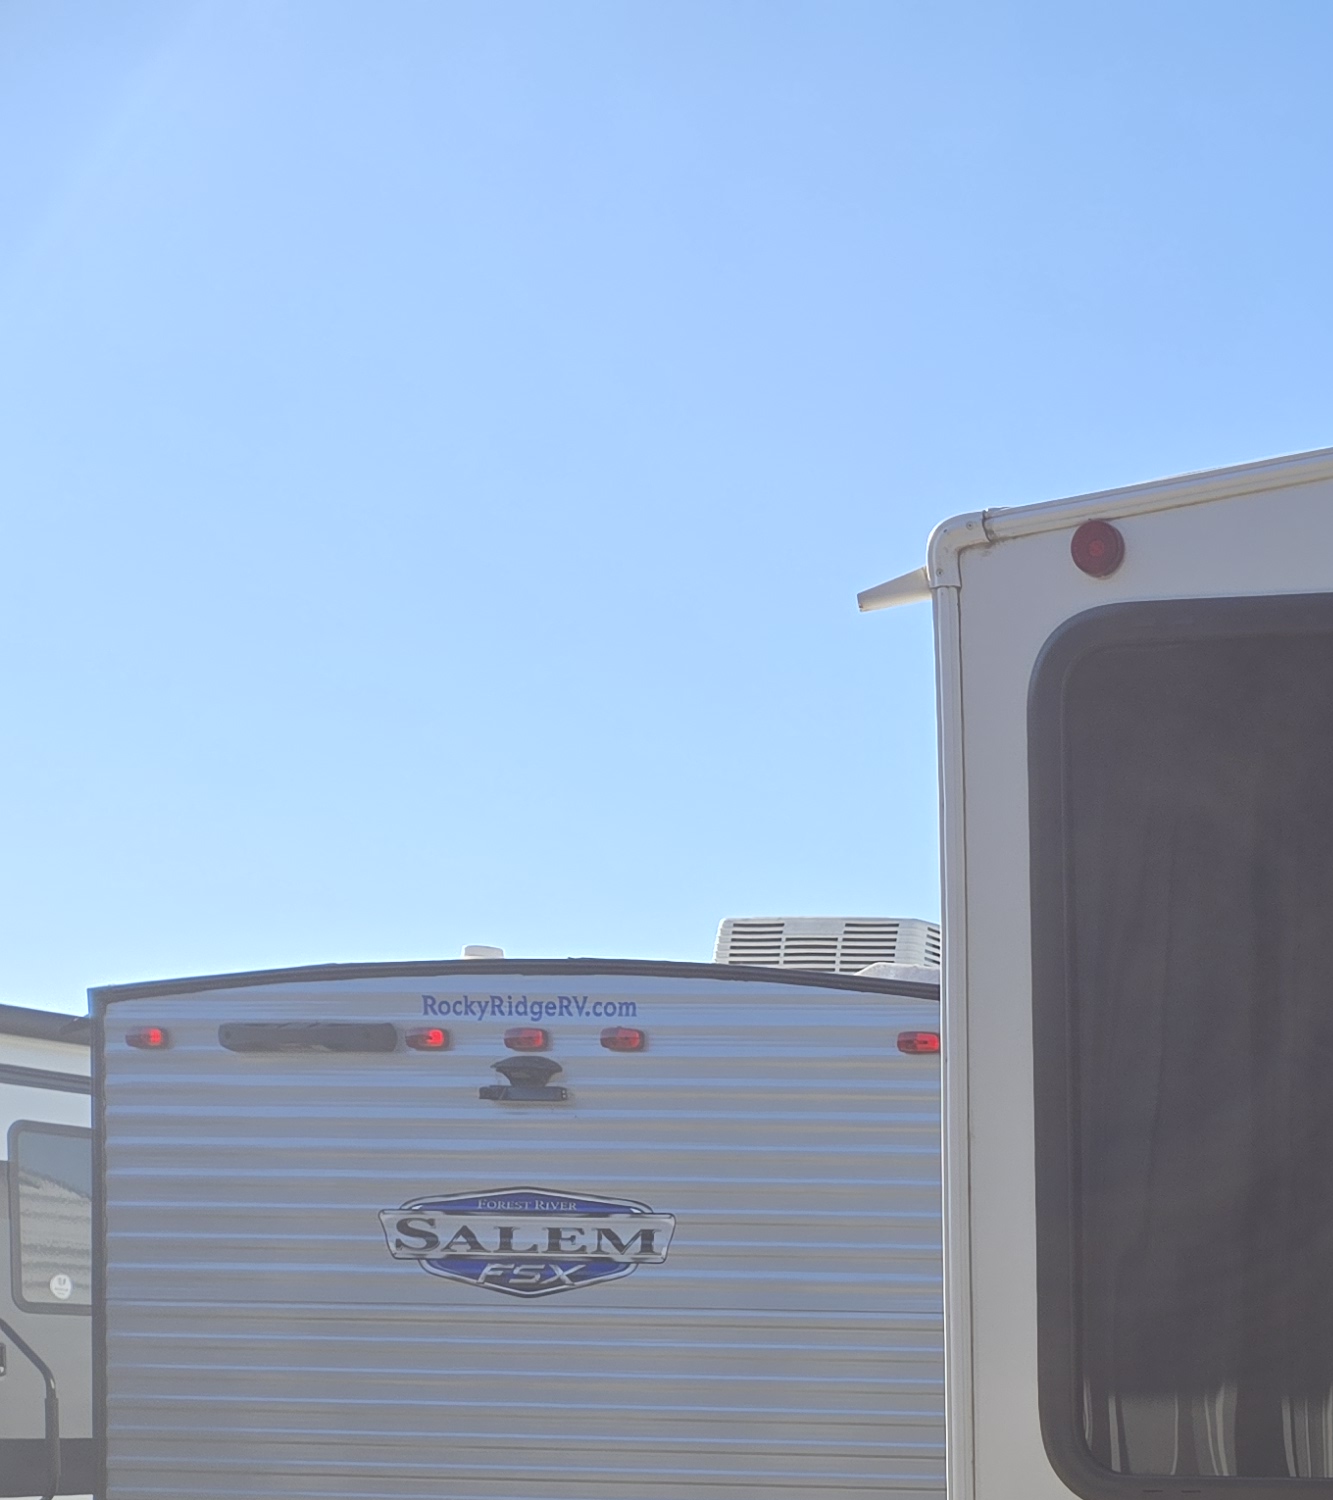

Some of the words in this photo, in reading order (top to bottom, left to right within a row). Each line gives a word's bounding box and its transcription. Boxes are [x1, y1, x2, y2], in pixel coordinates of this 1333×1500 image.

[422, 995, 637, 1020] RockyRidgeRV.com
[477, 1199, 532, 1210] FOREST
[534, 1200, 577, 1211] RIVER
[395, 1217, 661, 1255] SALEM
[476, 1263, 586, 1286] FSX
